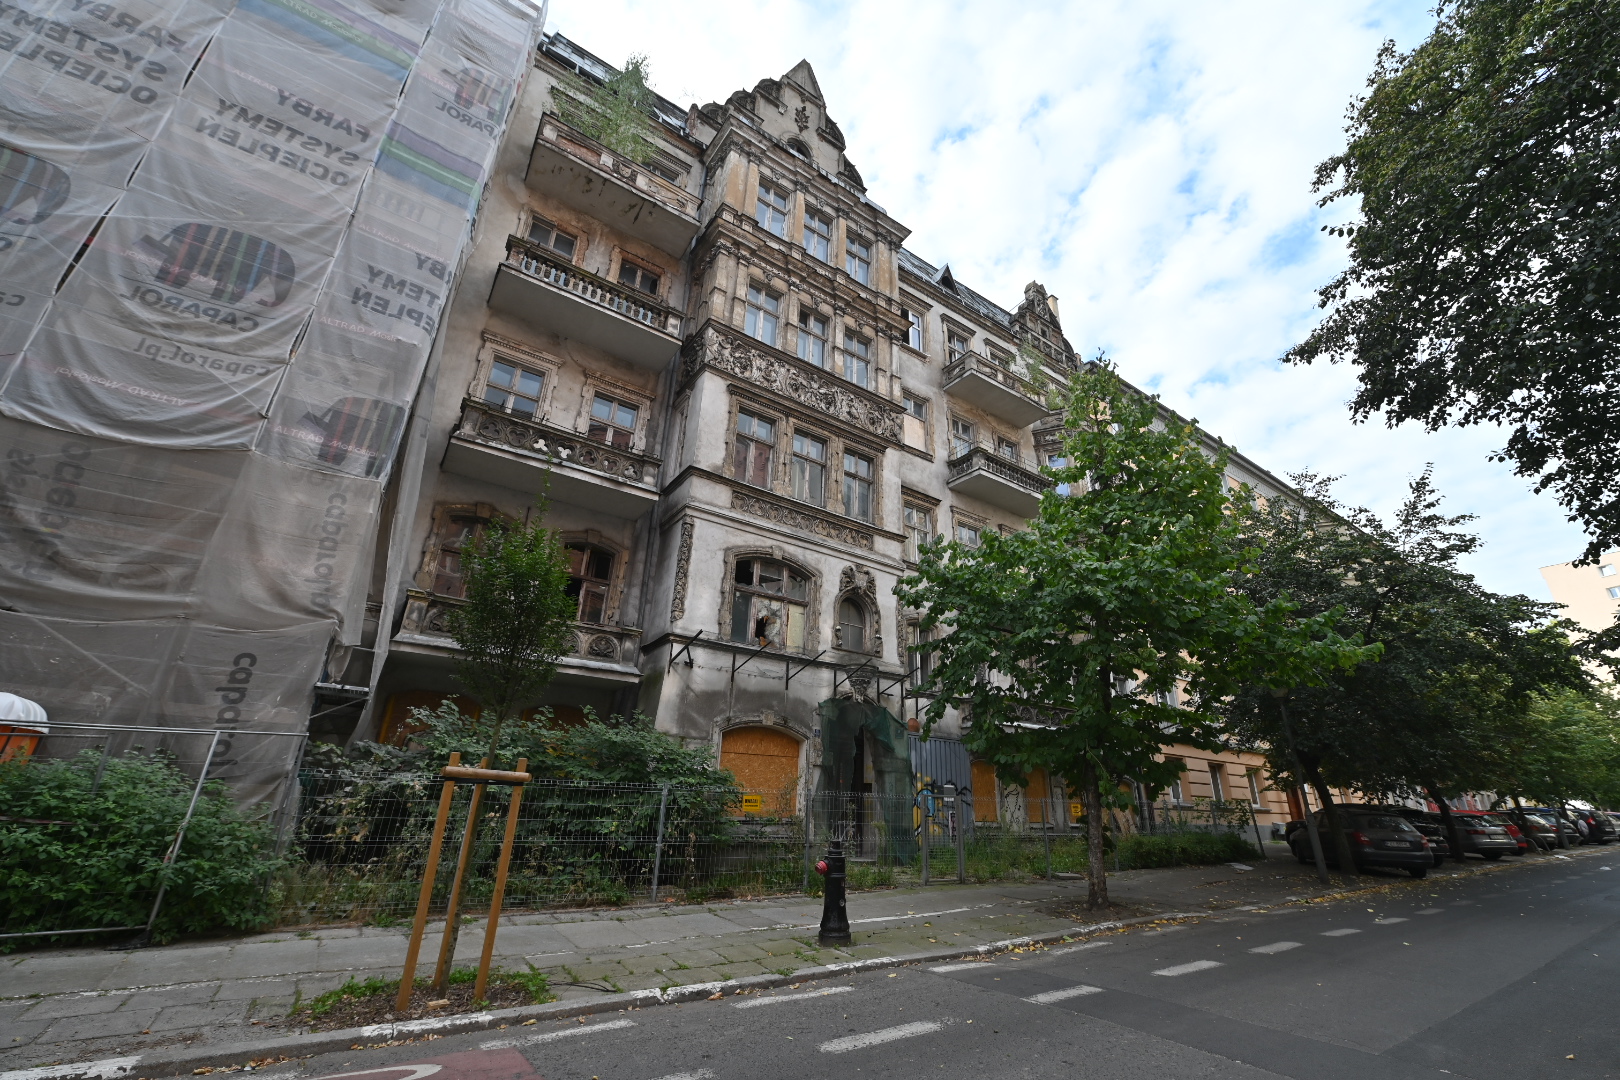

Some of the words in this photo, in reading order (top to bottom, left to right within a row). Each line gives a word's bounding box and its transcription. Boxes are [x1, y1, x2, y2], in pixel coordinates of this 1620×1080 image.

[280, 0, 318, 19] LTRAD
[320, 315, 366, 334] ALTRAD
[274, 425, 324, 444] ALTRAD
